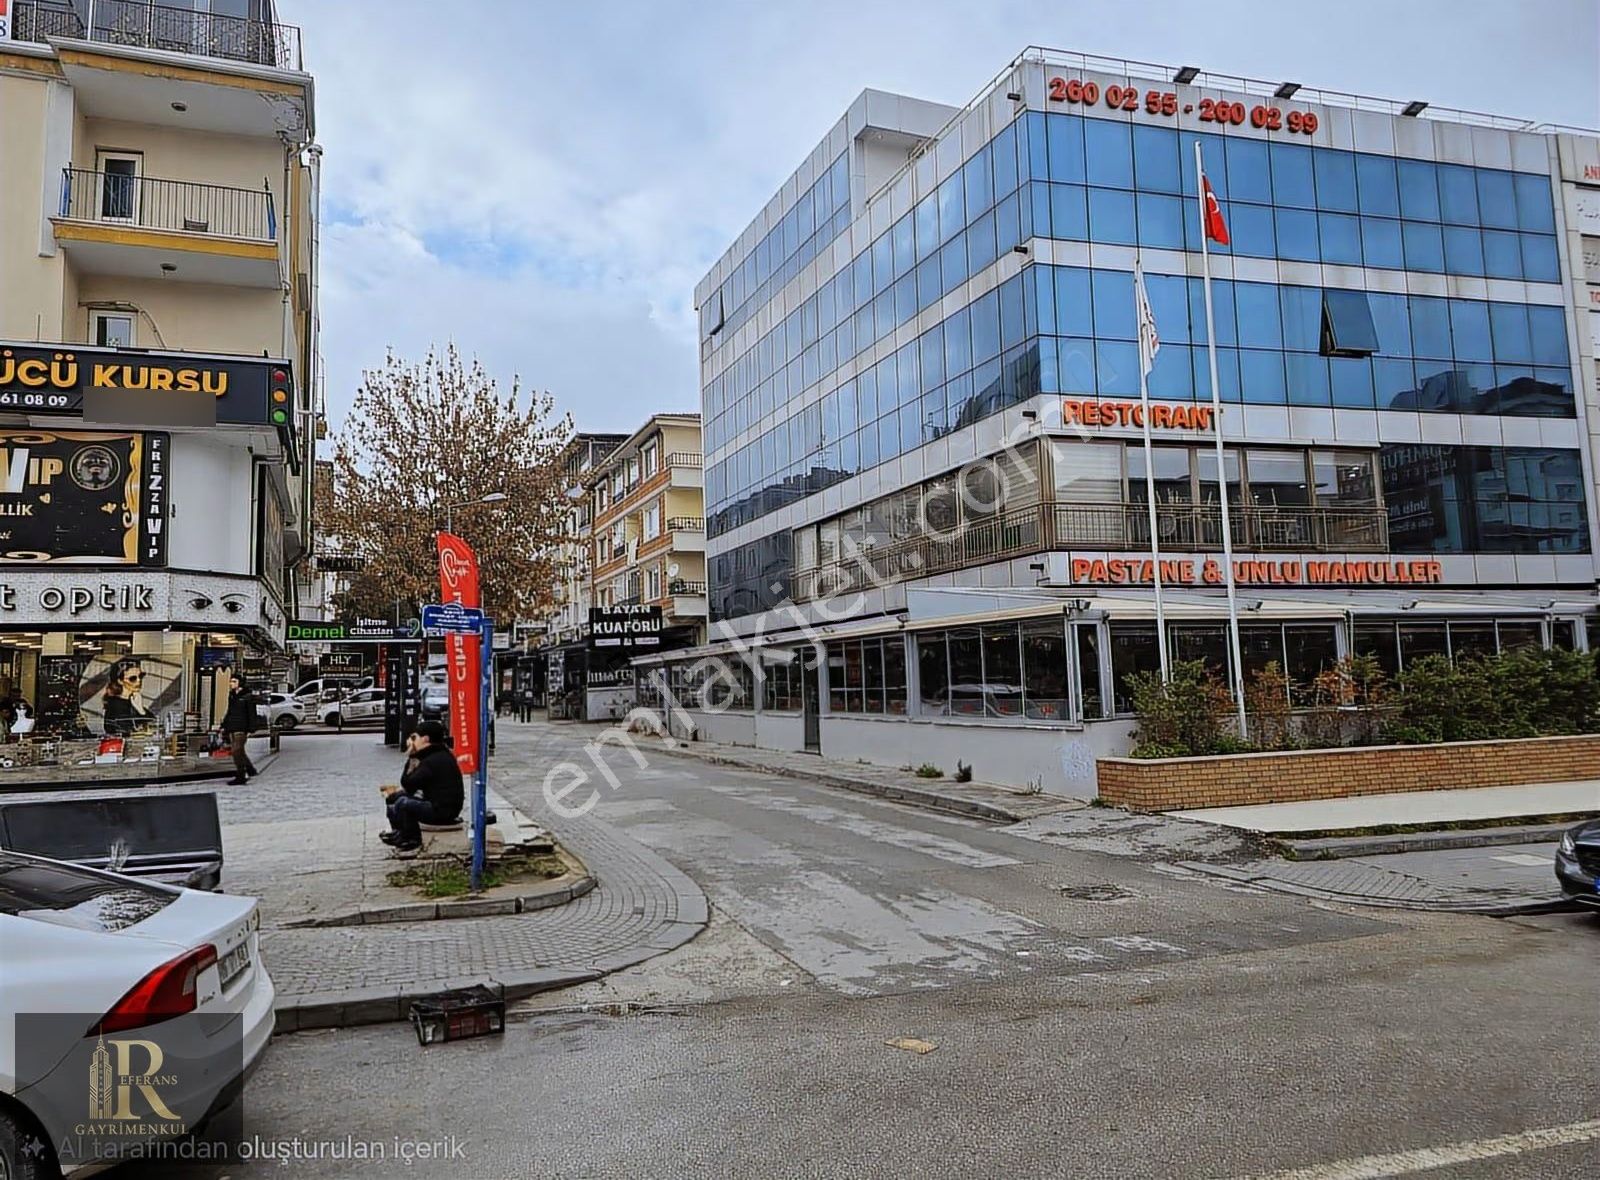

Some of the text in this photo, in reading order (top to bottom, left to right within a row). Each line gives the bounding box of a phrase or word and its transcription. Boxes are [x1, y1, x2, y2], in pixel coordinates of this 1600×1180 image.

[1050, 77, 1318, 135] 260 02 55 - 260 02 99
[94, 364, 227, 397] KURSU
[24, 394, 43, 405] 08
[48, 395, 68, 406] 09
[1072, 559, 1443, 584] PASTANE & UNLU MAMULLER
[39, 584, 154, 615] optik
[602, 604, 650, 614] BAYAN
[330, 655, 352, 665] HLY
